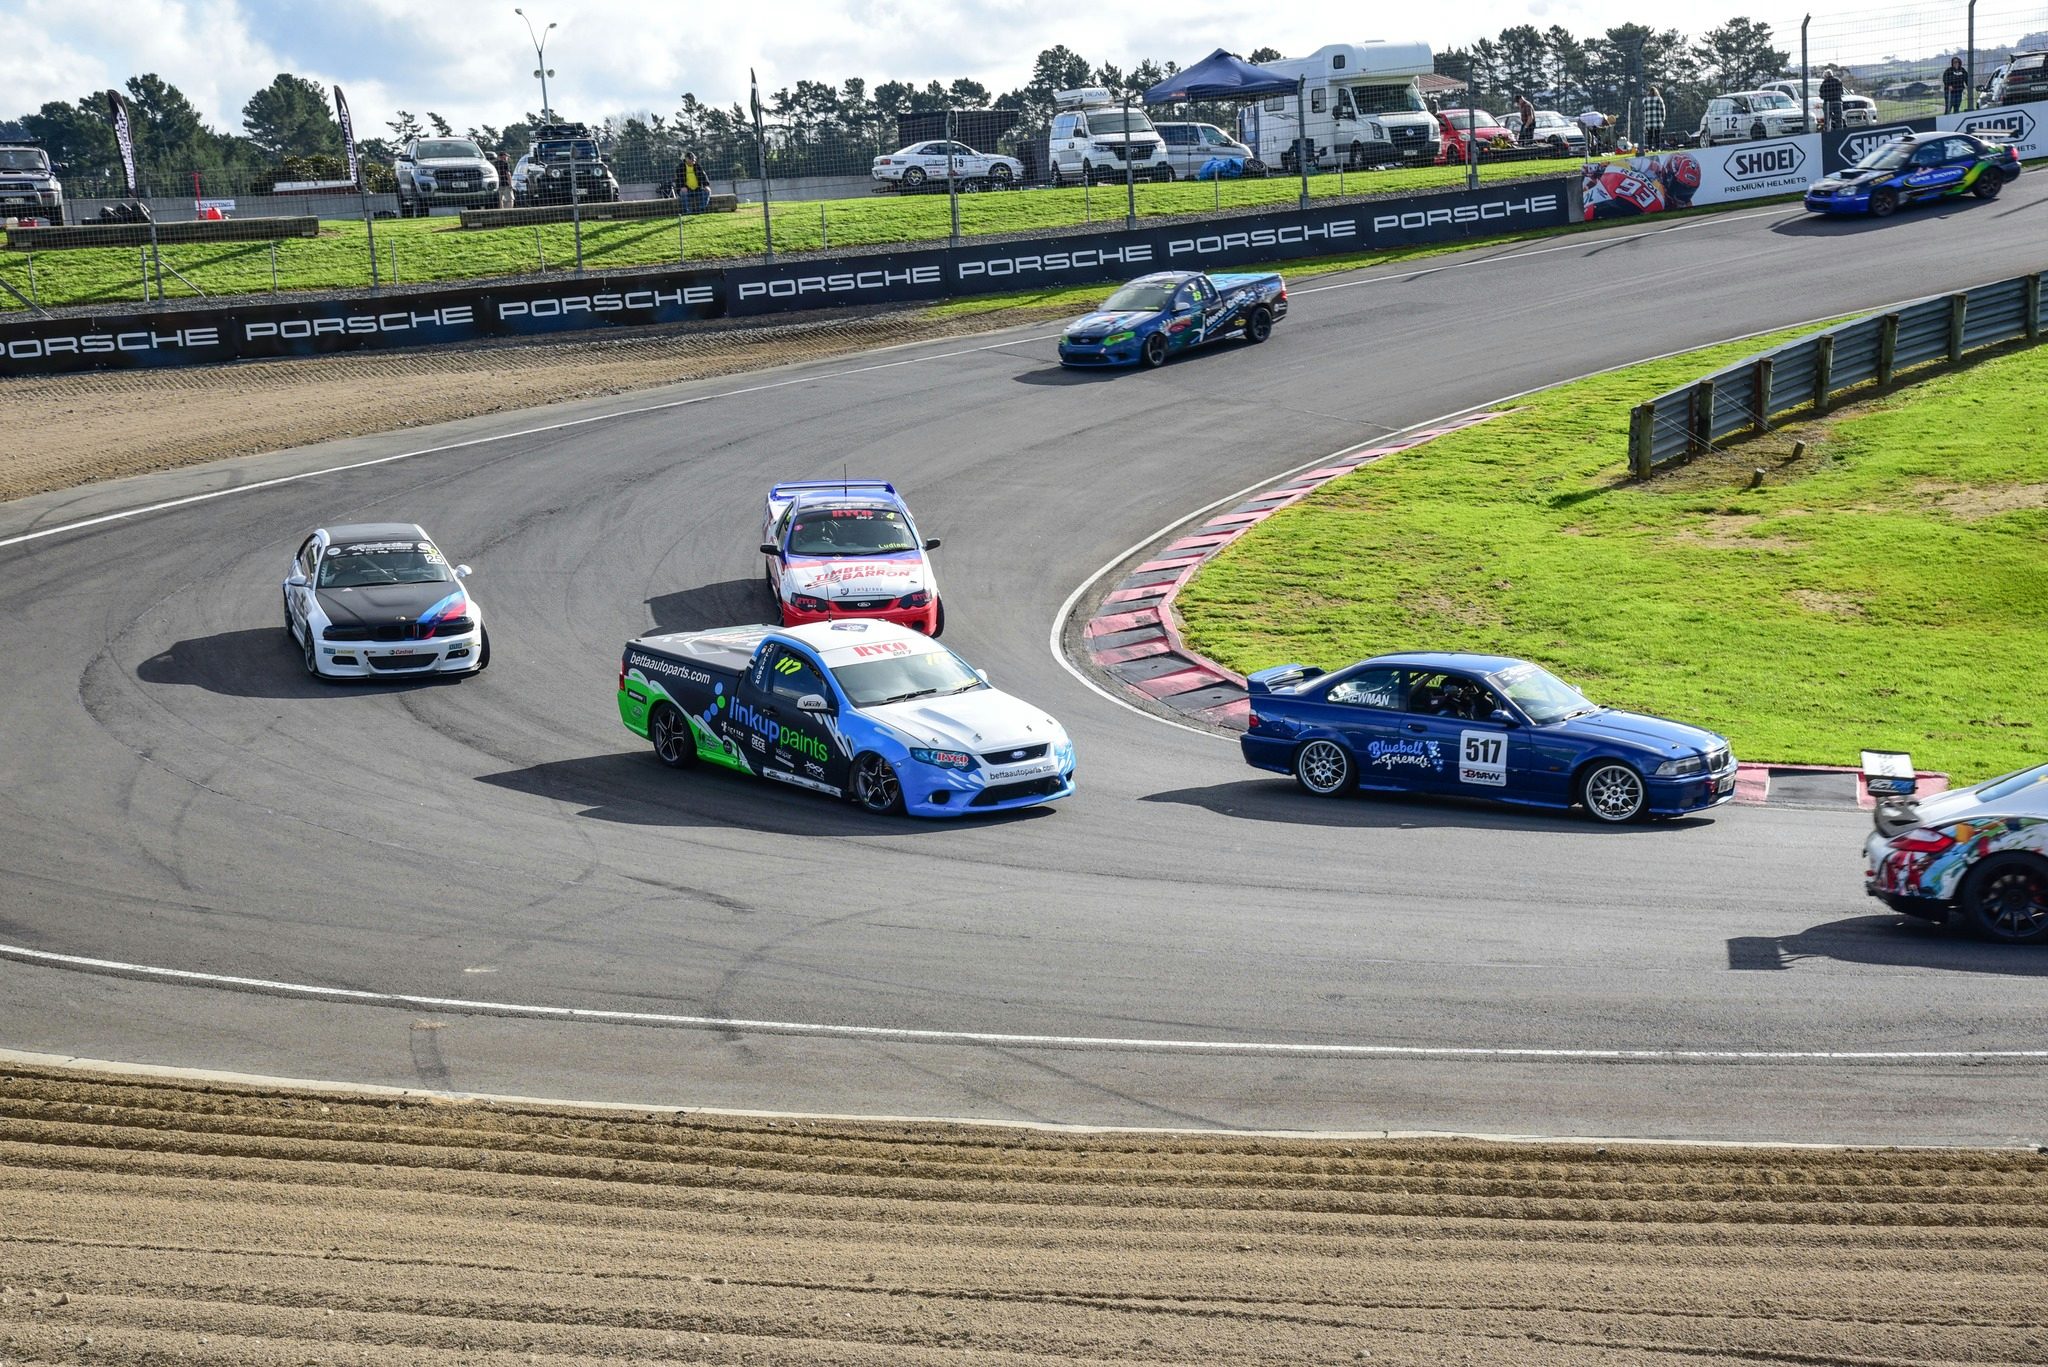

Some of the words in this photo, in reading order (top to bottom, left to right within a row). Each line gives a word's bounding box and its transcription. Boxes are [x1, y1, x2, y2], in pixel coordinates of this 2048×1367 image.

[1725, 116, 1738, 129] 12
[953, 157, 964, 168] 19
[1735, 149, 1794, 175] SHOEI
[1620, 168, 1658, 193] REPSOL
[1725, 182, 1764, 193] PREMIUM
[1767, 176, 1807, 188] HELMETS
[1374, 195, 1557, 233] PORSCHE
[1169, 219, 1356, 257] PORSCHE
[959, 244, 1152, 279] PORSCHE
[738, 266, 940, 300] PORSCHE
[499, 286, 714, 320] PORSCHE
[245, 306, 474, 341] PORSCHE
[426, 555, 443, 563] 25
[853, 642, 908, 657] RYCO
[630, 651, 711, 684] bettaautoparts.com
[755, 643, 775, 684] COLLINSON
[775, 657, 802, 675] 117
[936, 752, 969, 763] RYCO
[1367, 740, 1424, 758] Bluebell
[1466, 737, 1502, 763] 517
